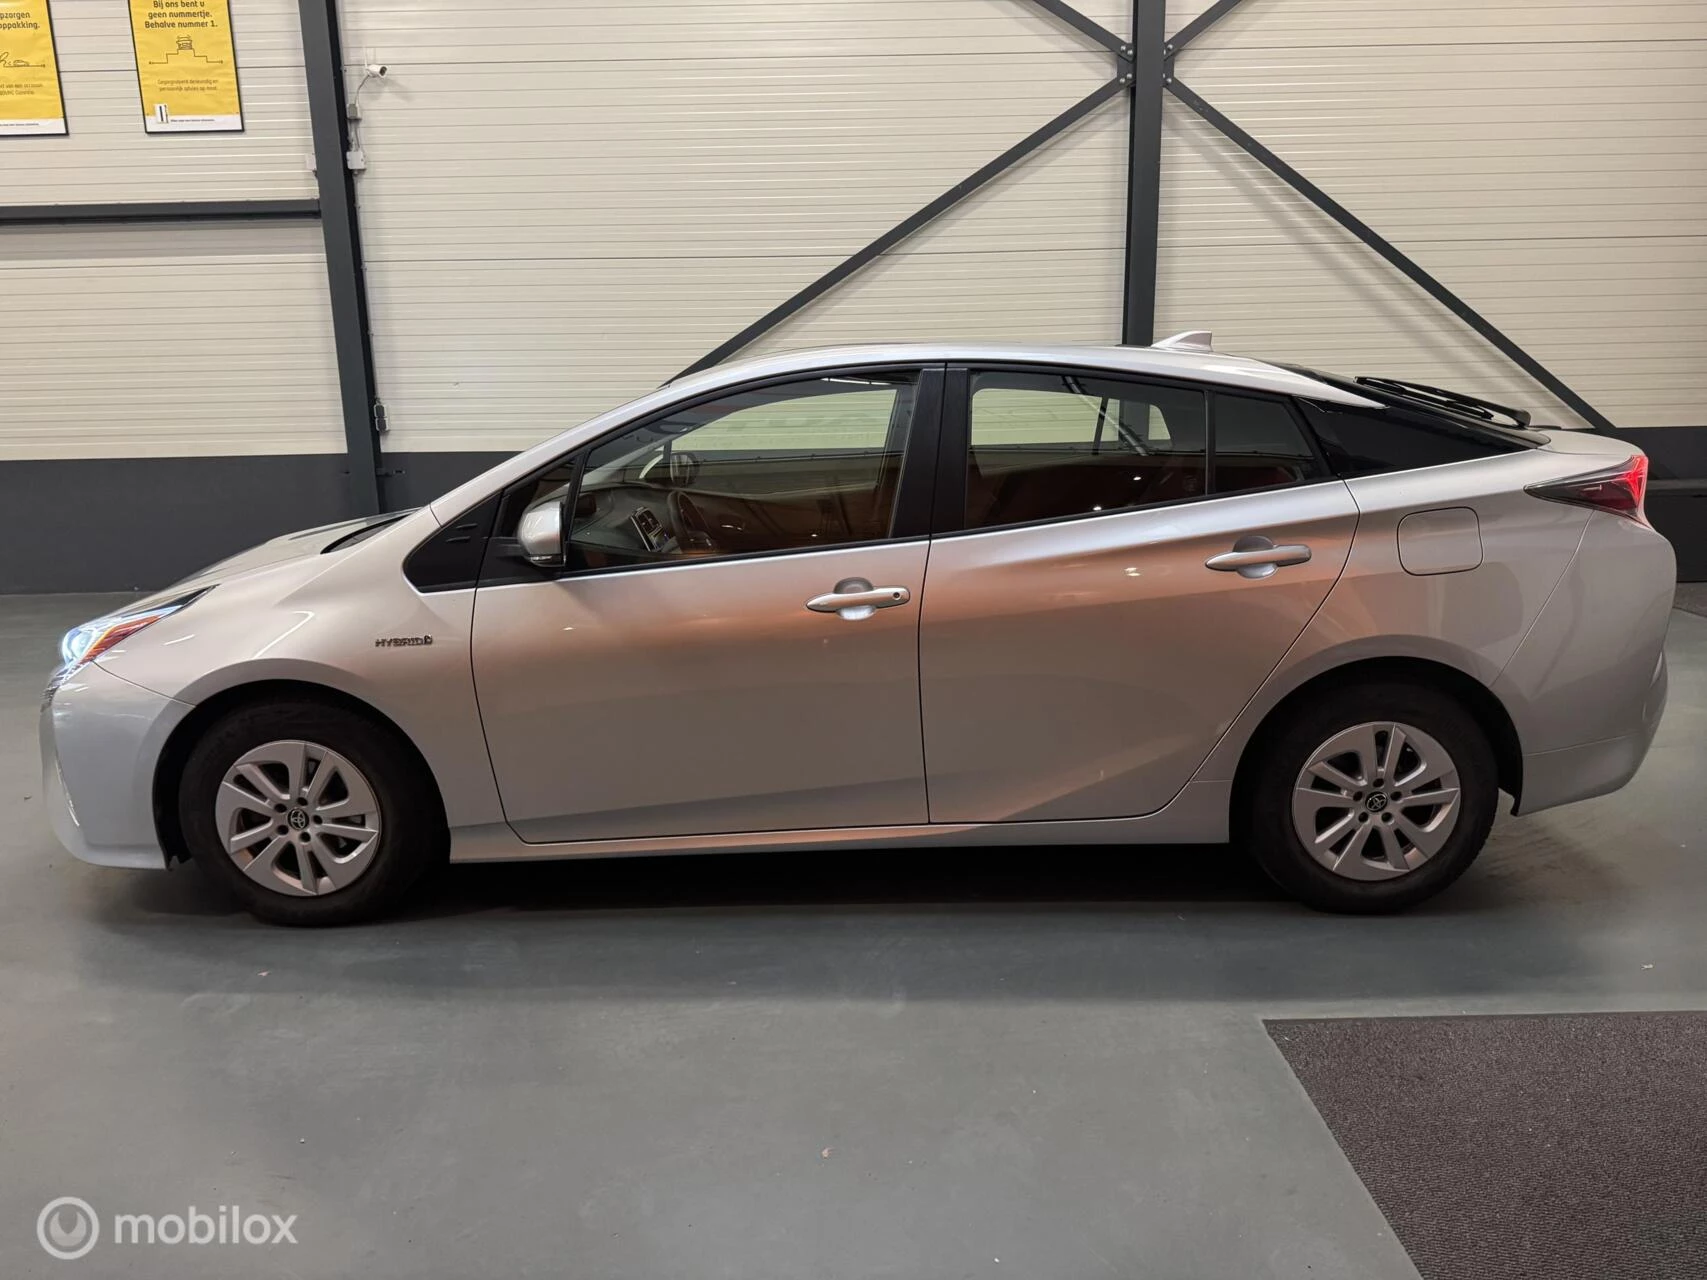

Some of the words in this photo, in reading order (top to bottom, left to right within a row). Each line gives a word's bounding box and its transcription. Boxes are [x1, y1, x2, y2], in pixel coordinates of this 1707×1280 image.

[153, 0, 164, 9] Bij
[181, 0, 198, 8] bent
[0, 12, 31, 20] pzorgen
[148, 12, 167, 20] geen
[169, 10, 213, 19] nummertje.
[145, 20, 176, 28] Behalve
[375, 637, 424, 648] HYBRID
